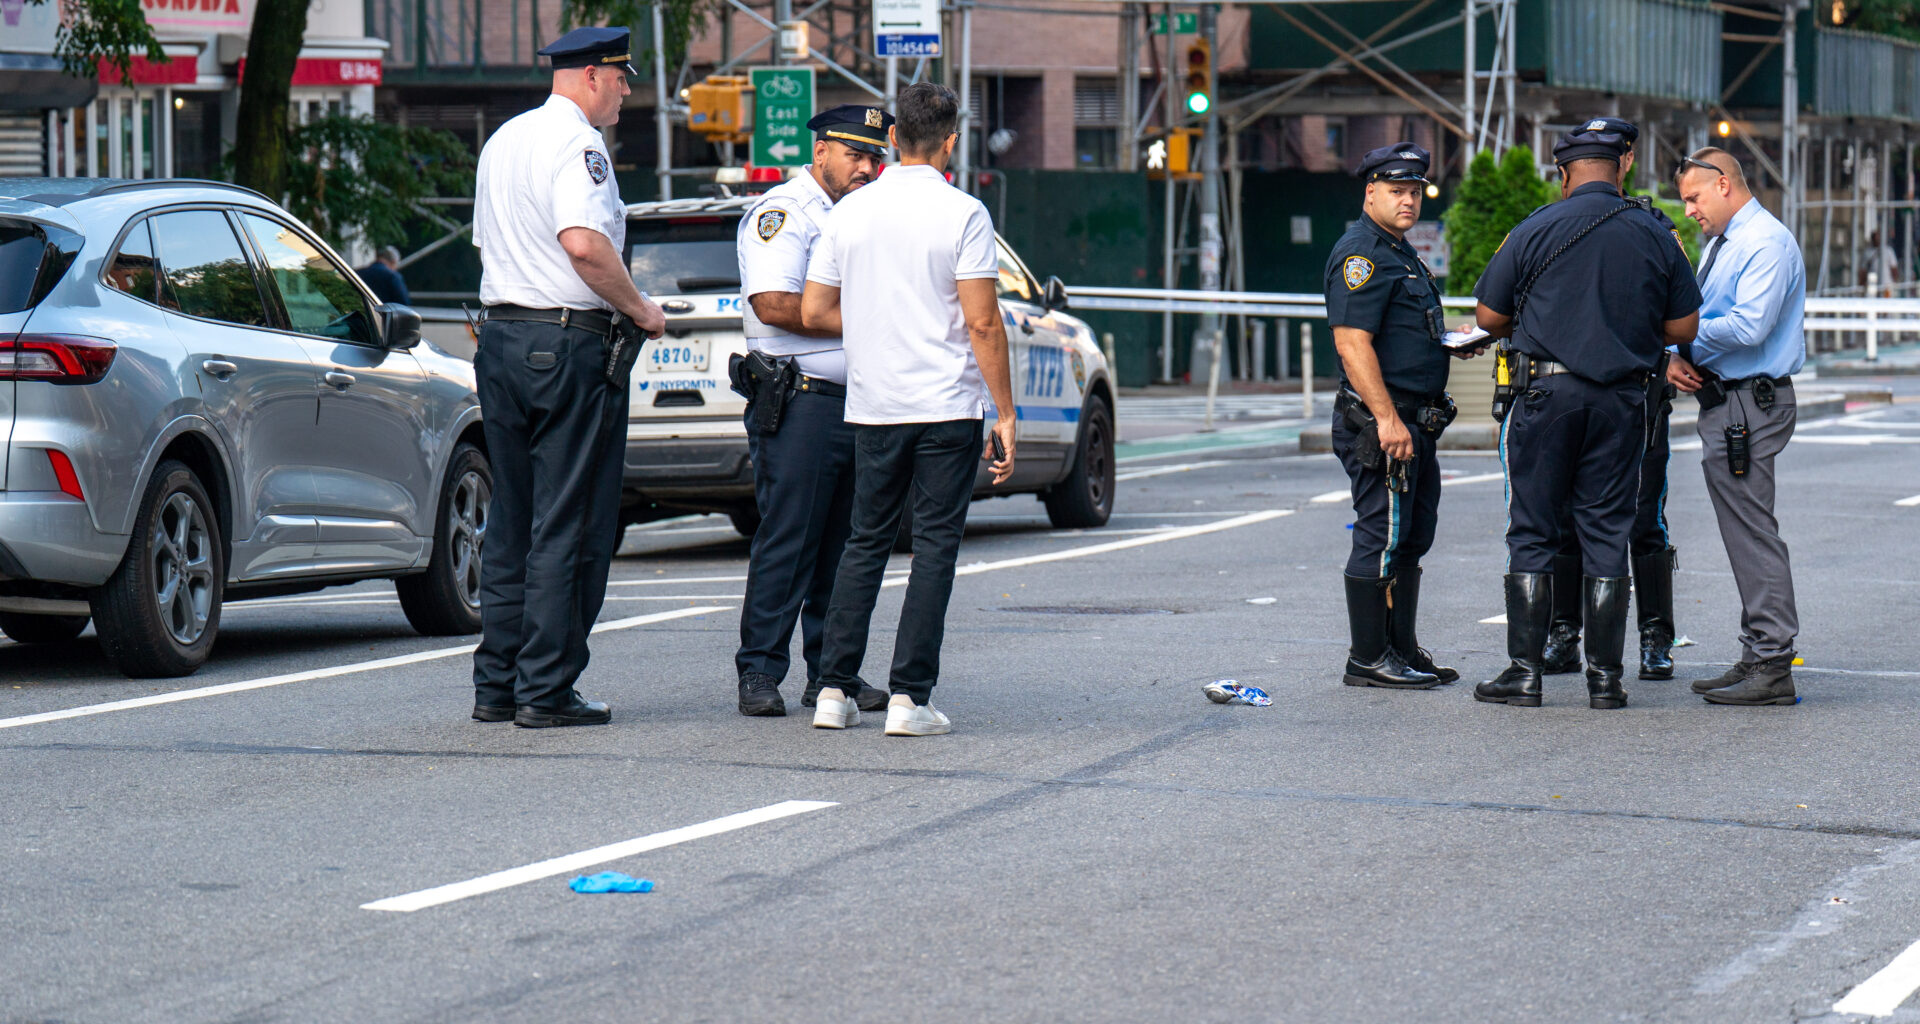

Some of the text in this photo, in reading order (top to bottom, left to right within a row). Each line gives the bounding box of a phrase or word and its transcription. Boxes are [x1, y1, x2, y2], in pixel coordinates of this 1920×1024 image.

[766, 105, 799, 120] East
[767, 123, 799, 137] Side
[652, 347, 691, 364] 4870
[1025, 344, 1065, 398] NYPD
[652, 380, 716, 391] @NYPDMTN
